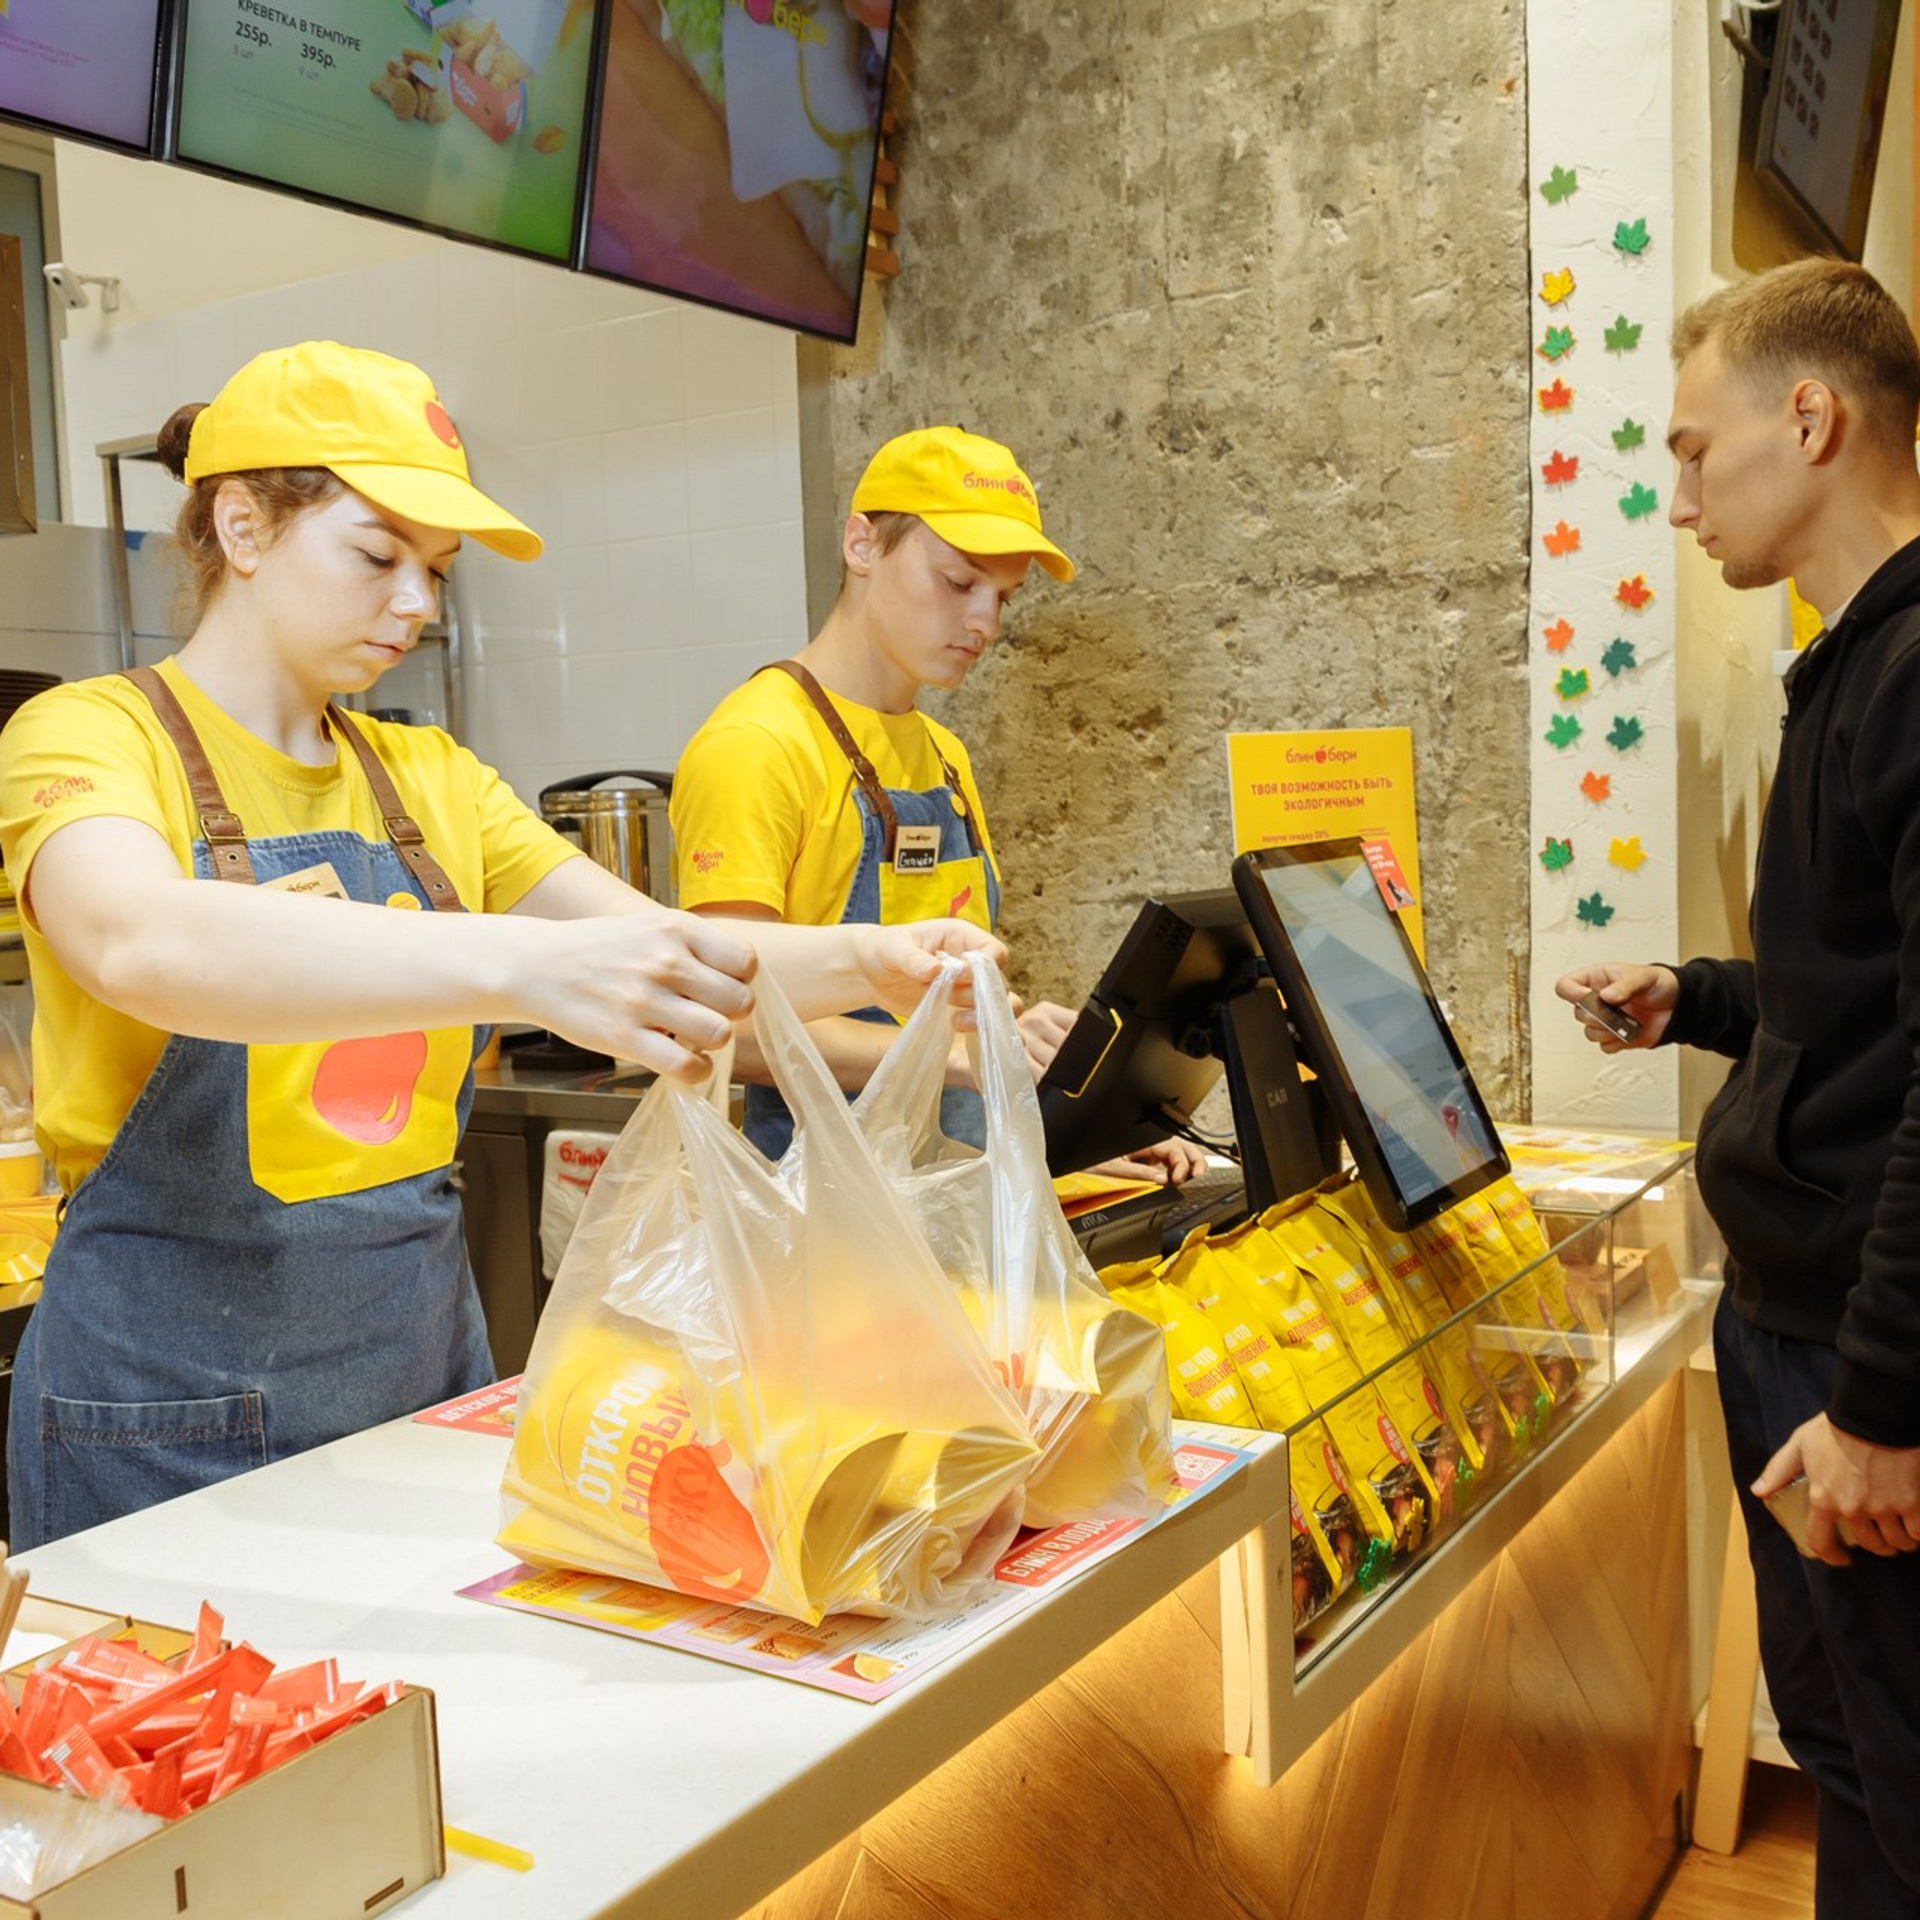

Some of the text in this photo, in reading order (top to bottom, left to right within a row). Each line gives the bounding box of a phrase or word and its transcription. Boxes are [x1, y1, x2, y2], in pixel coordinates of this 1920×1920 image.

[235, 20, 272, 47] 255р.
[237, 0, 361, 52] КРЕВЕТКА В ТЕМПУРЕ
[300, 43, 336, 69] 395р.
[1251, 777, 1393, 796] ТВОЯ ВОЗМОЖНОСТЬ БЫТЬ
[1284, 796, 1365, 811] ЭКОЛОГИЧНЫМ
[1001, 1547, 1057, 1577] БЛИН
